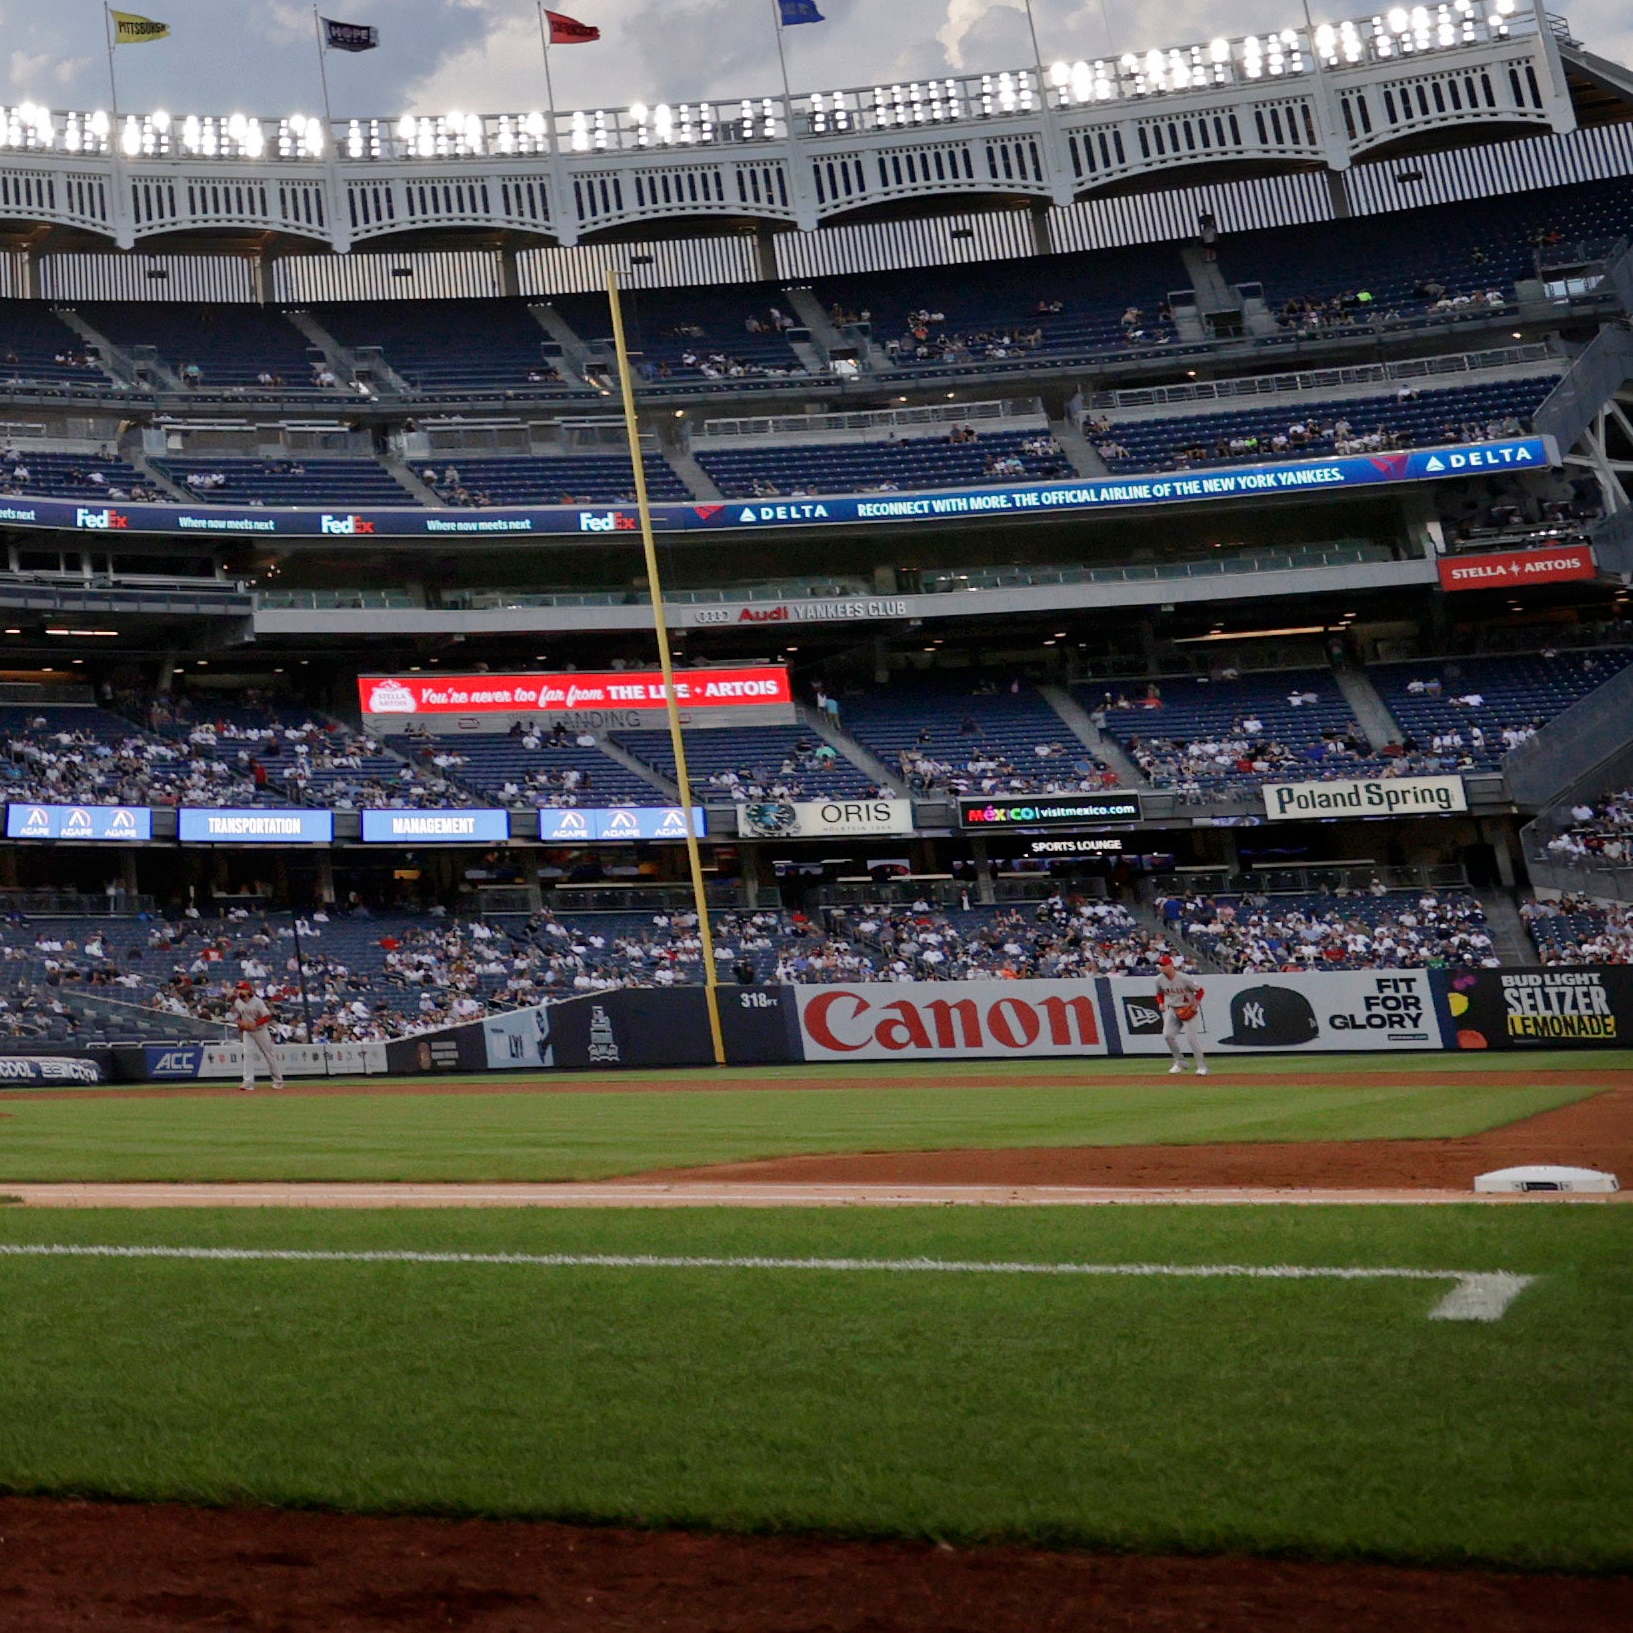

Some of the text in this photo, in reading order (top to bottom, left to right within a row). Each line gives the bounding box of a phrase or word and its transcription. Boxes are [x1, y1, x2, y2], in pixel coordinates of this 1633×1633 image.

[1450, 447, 1532, 468] DELTA
[858, 500, 931, 517] RECONNECT
[932, 499, 967, 513] WITH
[1013, 493, 1041, 508] THE
[1042, 488, 1100, 506] OFFICIAL
[1101, 483, 1151, 502] AIRLINE
[1153, 482, 1173, 498] OF
[1174, 479, 1201, 495] THE
[1202, 477, 1235, 493] NEW
[1236, 474, 1276, 489] YORK
[1277, 468, 1344, 485] YANKEES.
[77, 508, 127, 530] FedEx
[761, 504, 828, 521] DELTA
[322, 514, 374, 534] FedEx
[580, 512, 635, 531] FedEx
[1452, 558, 1581, 580] STELLA ARTOIS
[738, 599, 907, 622] Audi YANKEES CLUB
[421, 686, 469, 703] You're
[471, 691, 512, 703] never
[513, 687, 536, 702] too
[538, 686, 565, 708] far
[560, 685, 604, 707] from
[607, 685, 645, 700] THE
[705, 680, 778, 697] ARTOIS
[1277, 782, 1451, 814] Poland Spring
[821, 803, 892, 823] ORIS
[1041, 802, 1135, 819] visitmexico.com
[20, 827, 50, 836] AGAPE
[61, 828, 93, 837] AGAPE
[105, 828, 137, 837] AGAPE
[208, 817, 301, 834] TRANSPORTATION
[392, 818, 474, 834] MANAGEMENT
[552, 829, 588, 837] AGAPE
[602, 828, 641, 837] AGAPE
[654, 827, 687, 837] AGAP
[1032, 839, 1122, 853] SPORTS LOUNGE
[1376, 978, 1417, 993] FIT
[1501, 972, 1602, 986] BUD LIGHT
[1364, 996, 1422, 1011] FOR
[1503, 985, 1611, 1016] SELTZER
[804, 991, 1100, 1051] Canon
[1329, 1013, 1423, 1030] GLORY
[1511, 1016, 1615, 1036] LEMONADE
[155, 1053, 195, 1069] ACC
